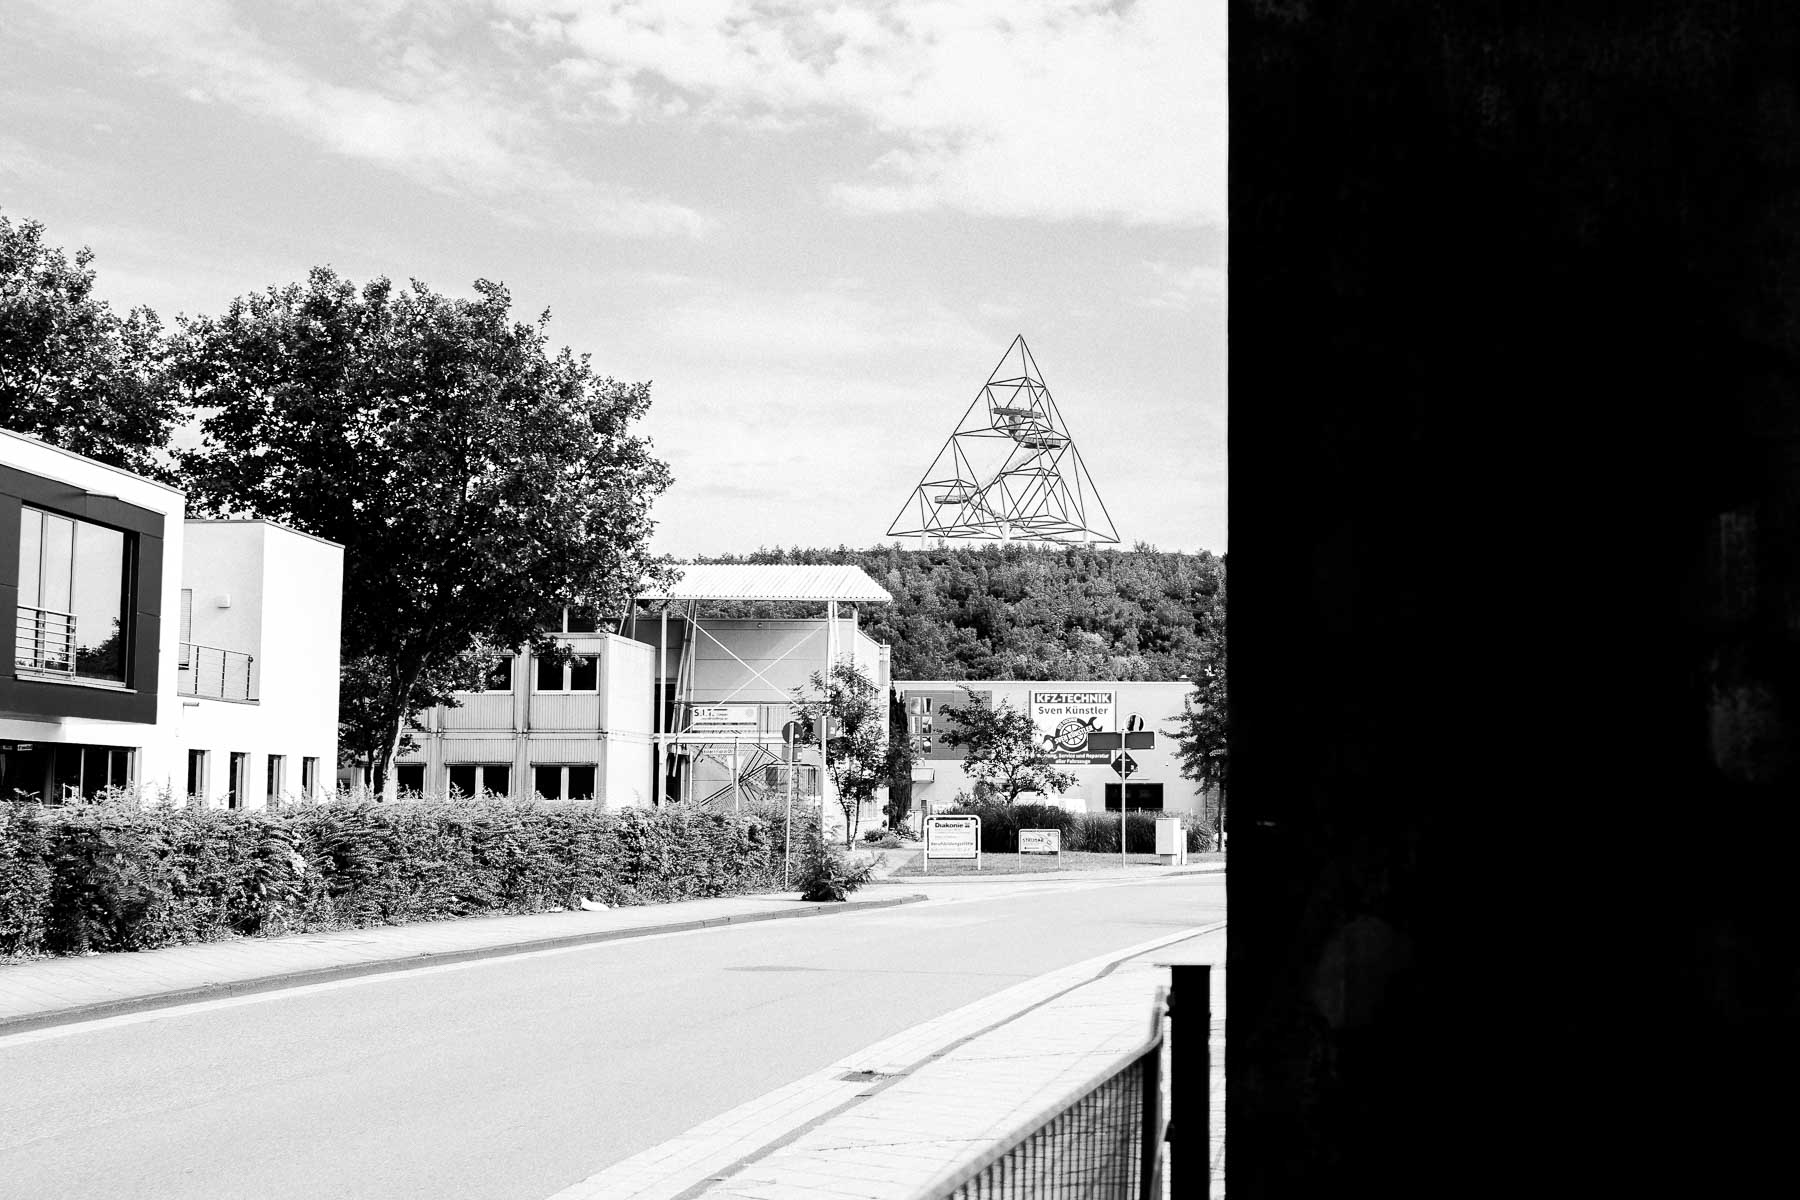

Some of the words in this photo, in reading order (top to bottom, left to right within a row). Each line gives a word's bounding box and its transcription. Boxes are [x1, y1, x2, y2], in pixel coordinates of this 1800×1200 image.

[1036, 693, 1111, 703] KFZ-TECHNIK
[1038, 706, 1063, 714] Sven
[1065, 706, 1108, 714] Künstler
